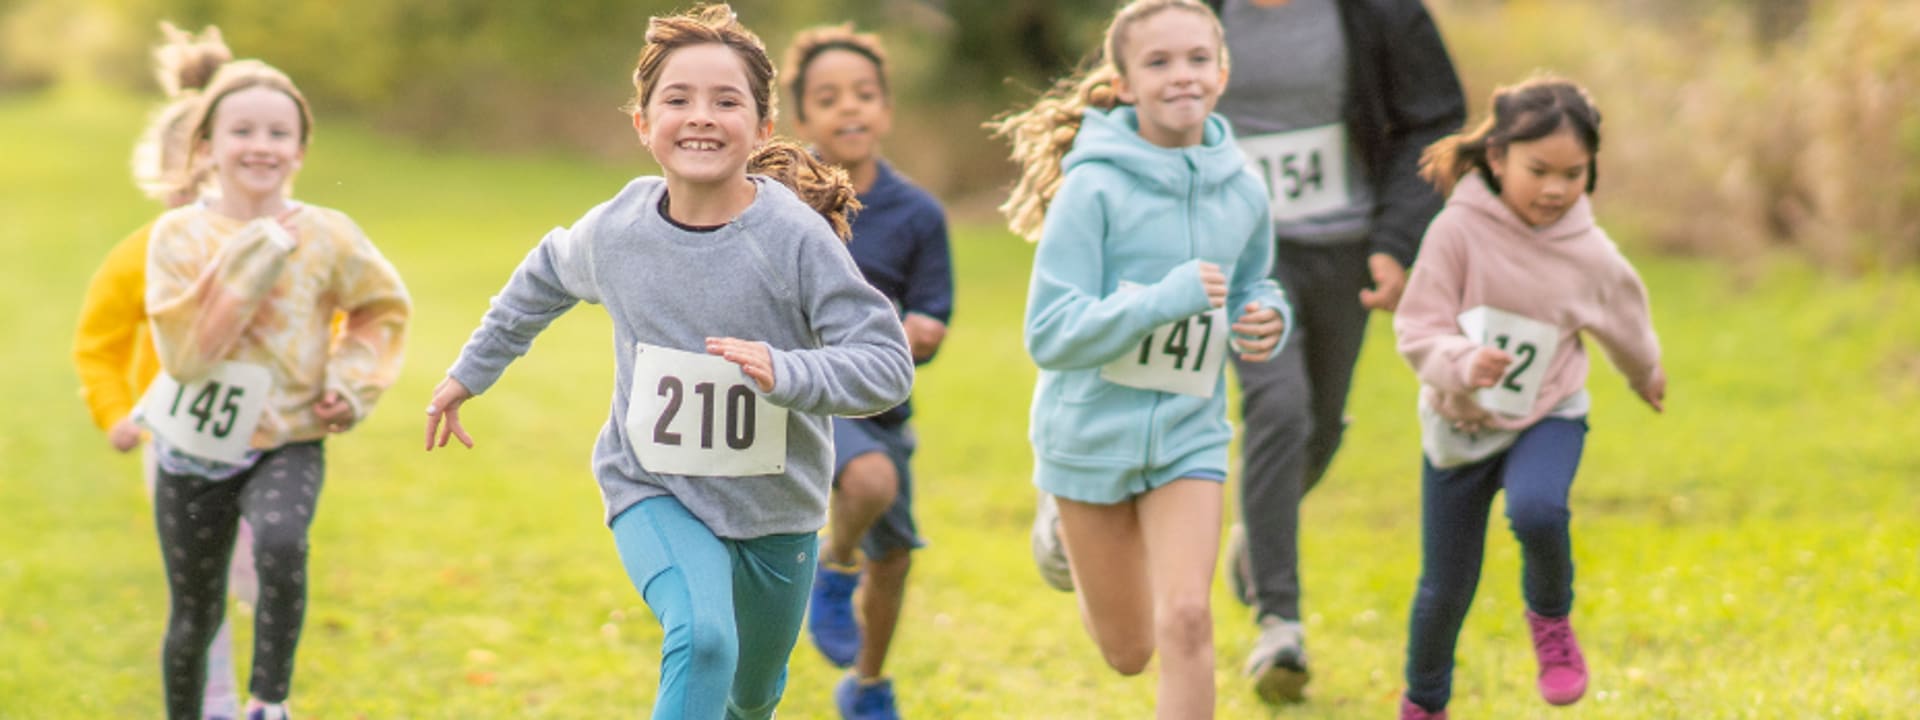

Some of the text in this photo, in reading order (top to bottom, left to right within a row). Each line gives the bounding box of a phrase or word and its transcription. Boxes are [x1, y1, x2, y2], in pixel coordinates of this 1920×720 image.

[1257, 149, 1323, 200] 154
[1138, 314, 1213, 371] 147
[169, 379, 244, 438] 145
[653, 375, 756, 450] 210
